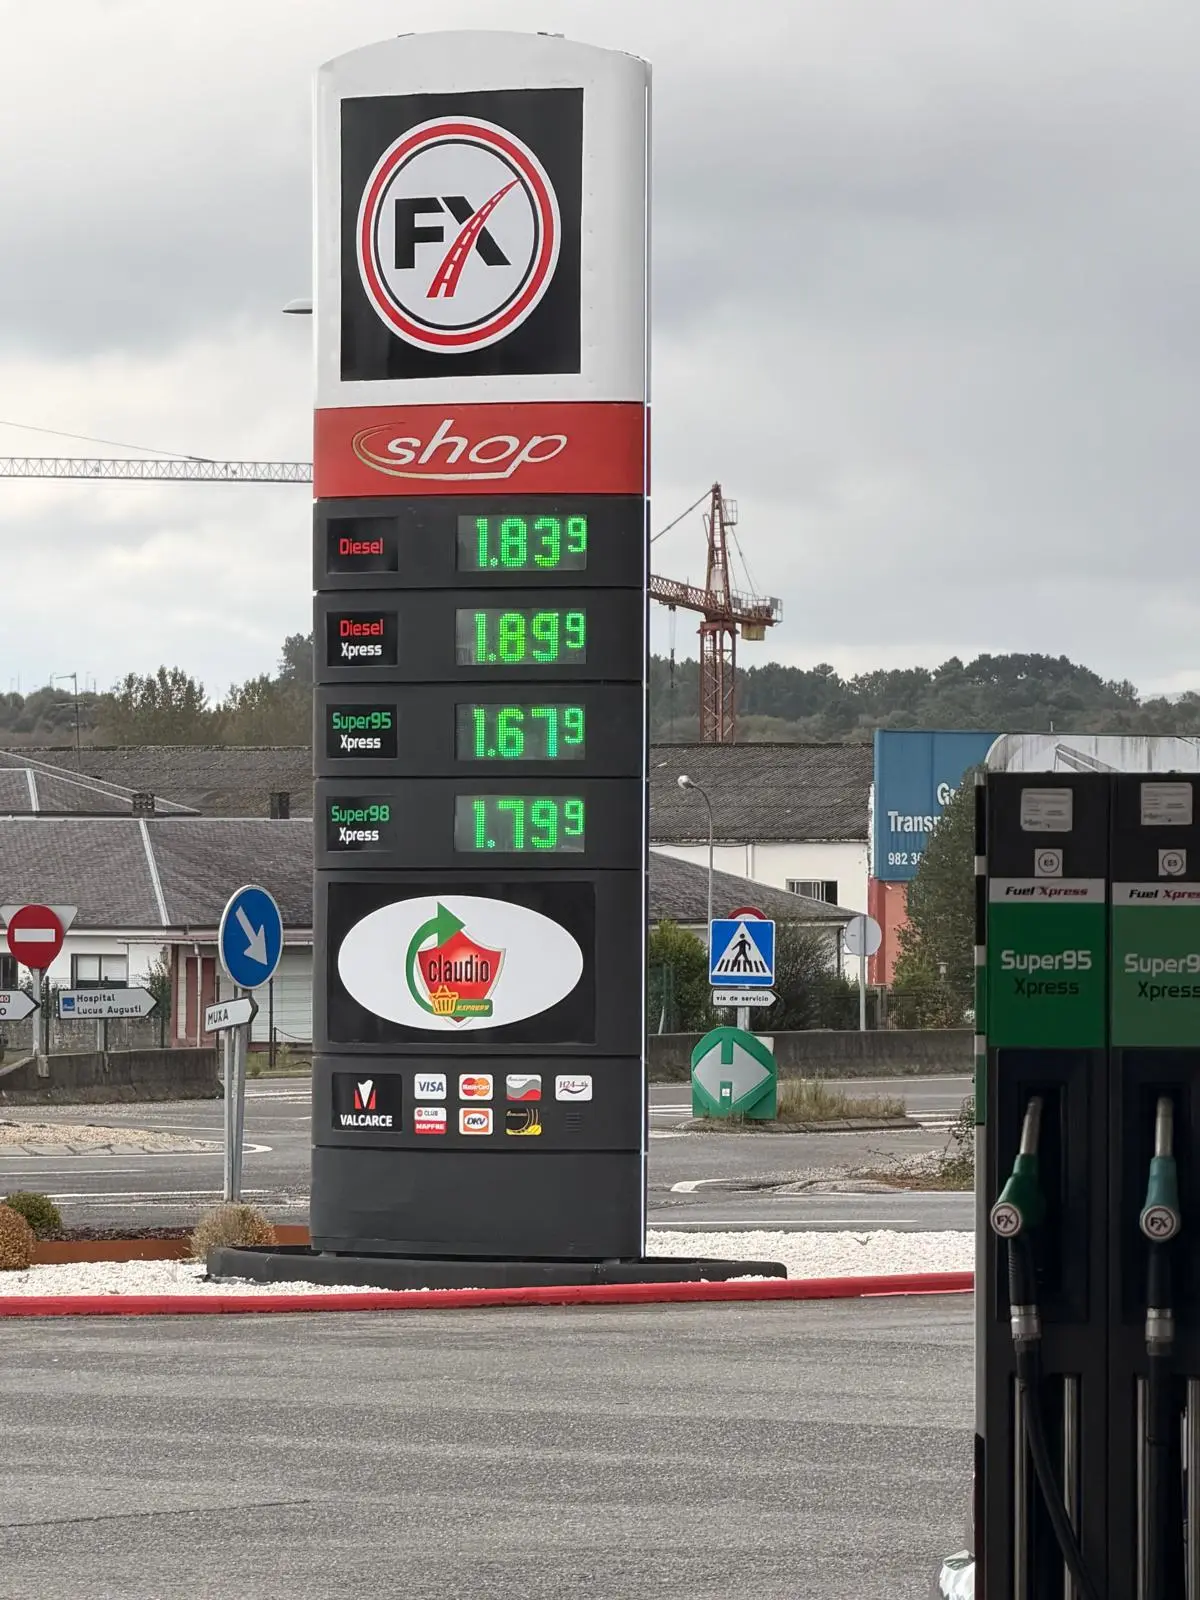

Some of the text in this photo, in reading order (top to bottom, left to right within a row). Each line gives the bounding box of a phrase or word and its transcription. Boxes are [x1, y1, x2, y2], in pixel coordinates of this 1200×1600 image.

[394, 177, 521, 298] FX
[385, 419, 568, 479] shop
[339, 537, 384, 555] Diesel
[339, 619, 384, 637] Diesel
[341, 642, 382, 659] Xpress
[332, 712, 392, 731] Super95
[340, 734, 381, 752] Xpress
[331, 804, 391, 825] Super98
[339, 827, 380, 844] Xpress
[888, 852, 908, 865] 982
[1005, 886, 1088, 897] Fuel Xpress
[1128, 889, 1159, 899] Fuel
[429, 953, 490, 983] claudio
[1001, 950, 1092, 974] Super95
[1014, 977, 1080, 998] Xpress
[76, 993, 116, 1005] Hospital
[76, 1004, 142, 1016] Lucus Augusti
[418, 1081, 444, 1092] VISA
[340, 1114, 393, 1127] VALCARCE
[467, 1117, 485, 1126] DKV
